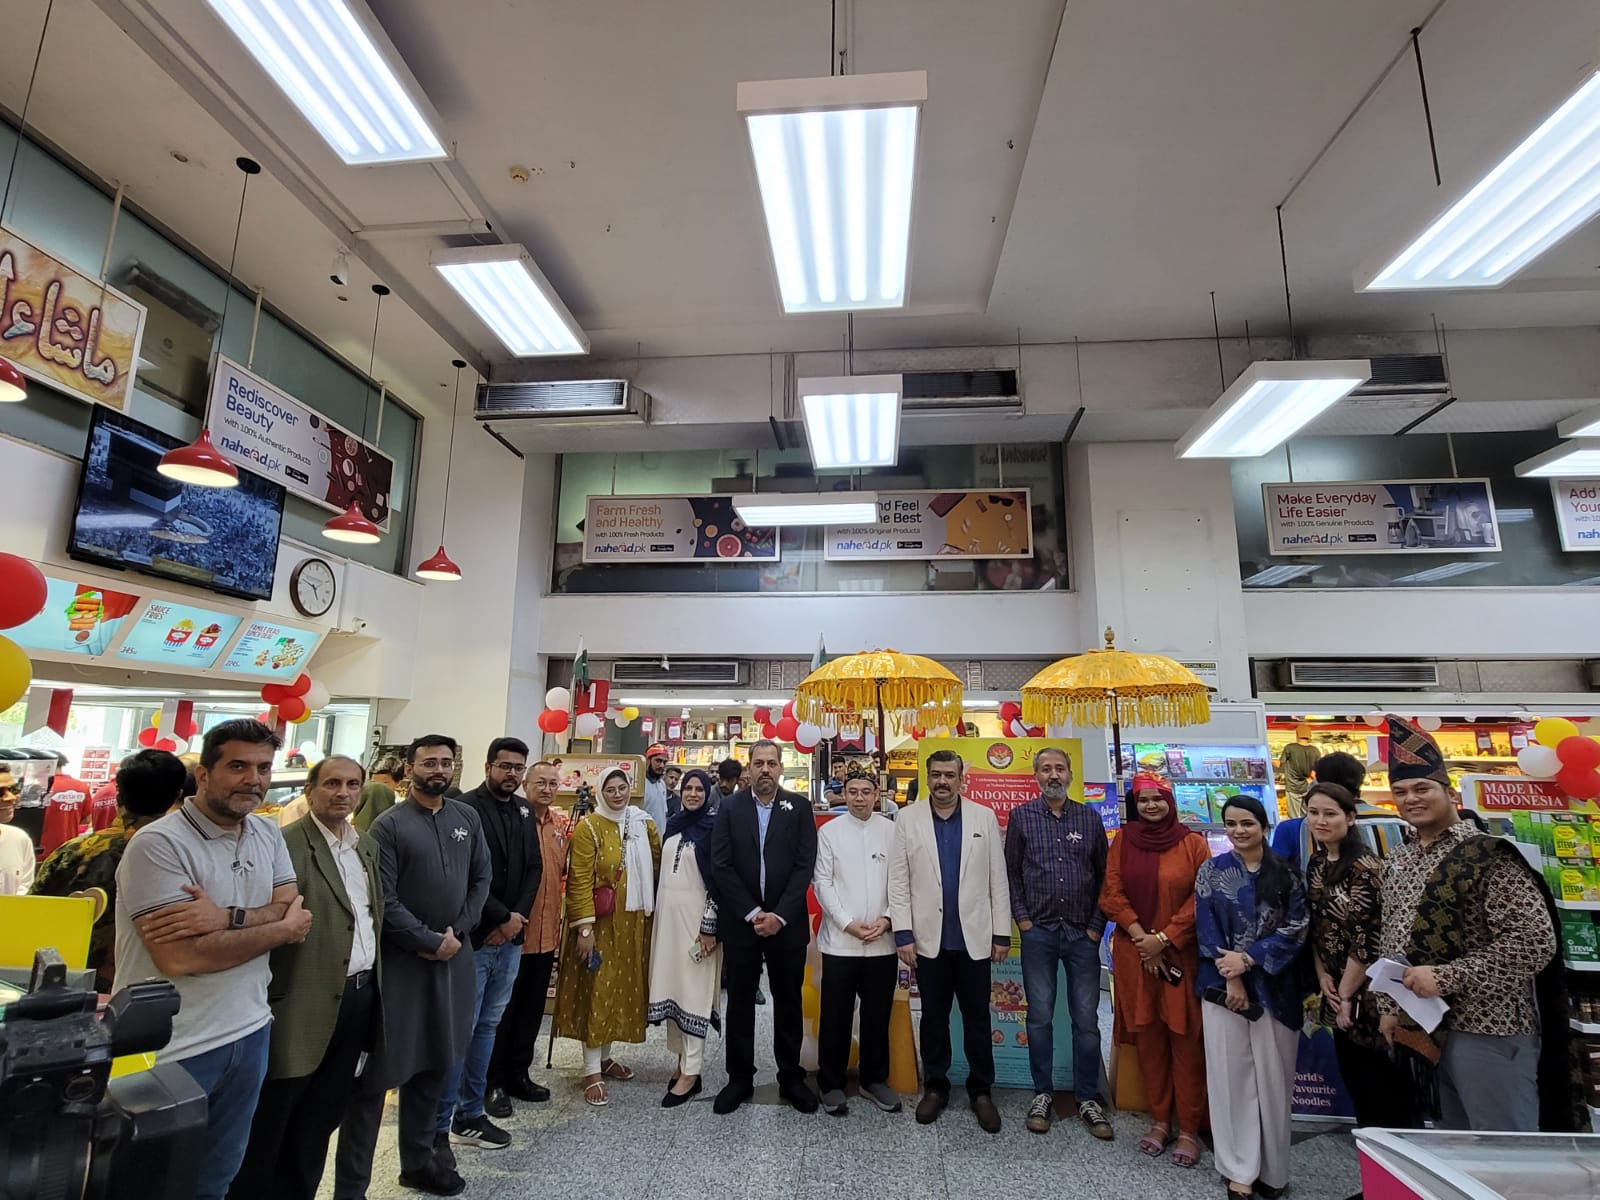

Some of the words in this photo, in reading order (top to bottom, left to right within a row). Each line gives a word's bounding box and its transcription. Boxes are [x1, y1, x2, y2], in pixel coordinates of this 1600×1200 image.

[228, 376, 299, 427] Rediscover
[226, 394, 274, 433] Beauty
[224, 416, 240, 430] with
[240, 423, 258, 440] 100%
[258, 434, 287, 454] Authentic
[287, 447, 312, 466] Products
[1277, 493, 1313, 505] Make
[1315, 491, 1377, 506] Everyday
[1569, 487, 1597, 499] Add
[596, 505, 627, 516] Farm
[629, 504, 662, 516] Fresh
[894, 499, 920, 511] Feel
[893, 512, 922, 524] Best
[1279, 506, 1303, 519] Life
[1306, 506, 1347, 518] Easier
[595, 517, 617, 528] and
[619, 516, 664, 529] Healthy
[1280, 520, 1296, 528] with
[1297, 520, 1315, 528] 100%
[1343, 519, 1375, 527] Products
[868, 527, 892, 536] Original
[893, 527, 921, 535] Products
[144, 610, 165, 620] FRIES
[150, 604, 172, 615] SAUCE
[1483, 782, 1526, 795] MADE
[1529, 783, 1544, 795] IN
[990, 801, 1022, 812] WEE
[1485, 794, 1564, 807] INDONESIA
[1291, 1096, 1331, 1107] Noodles
